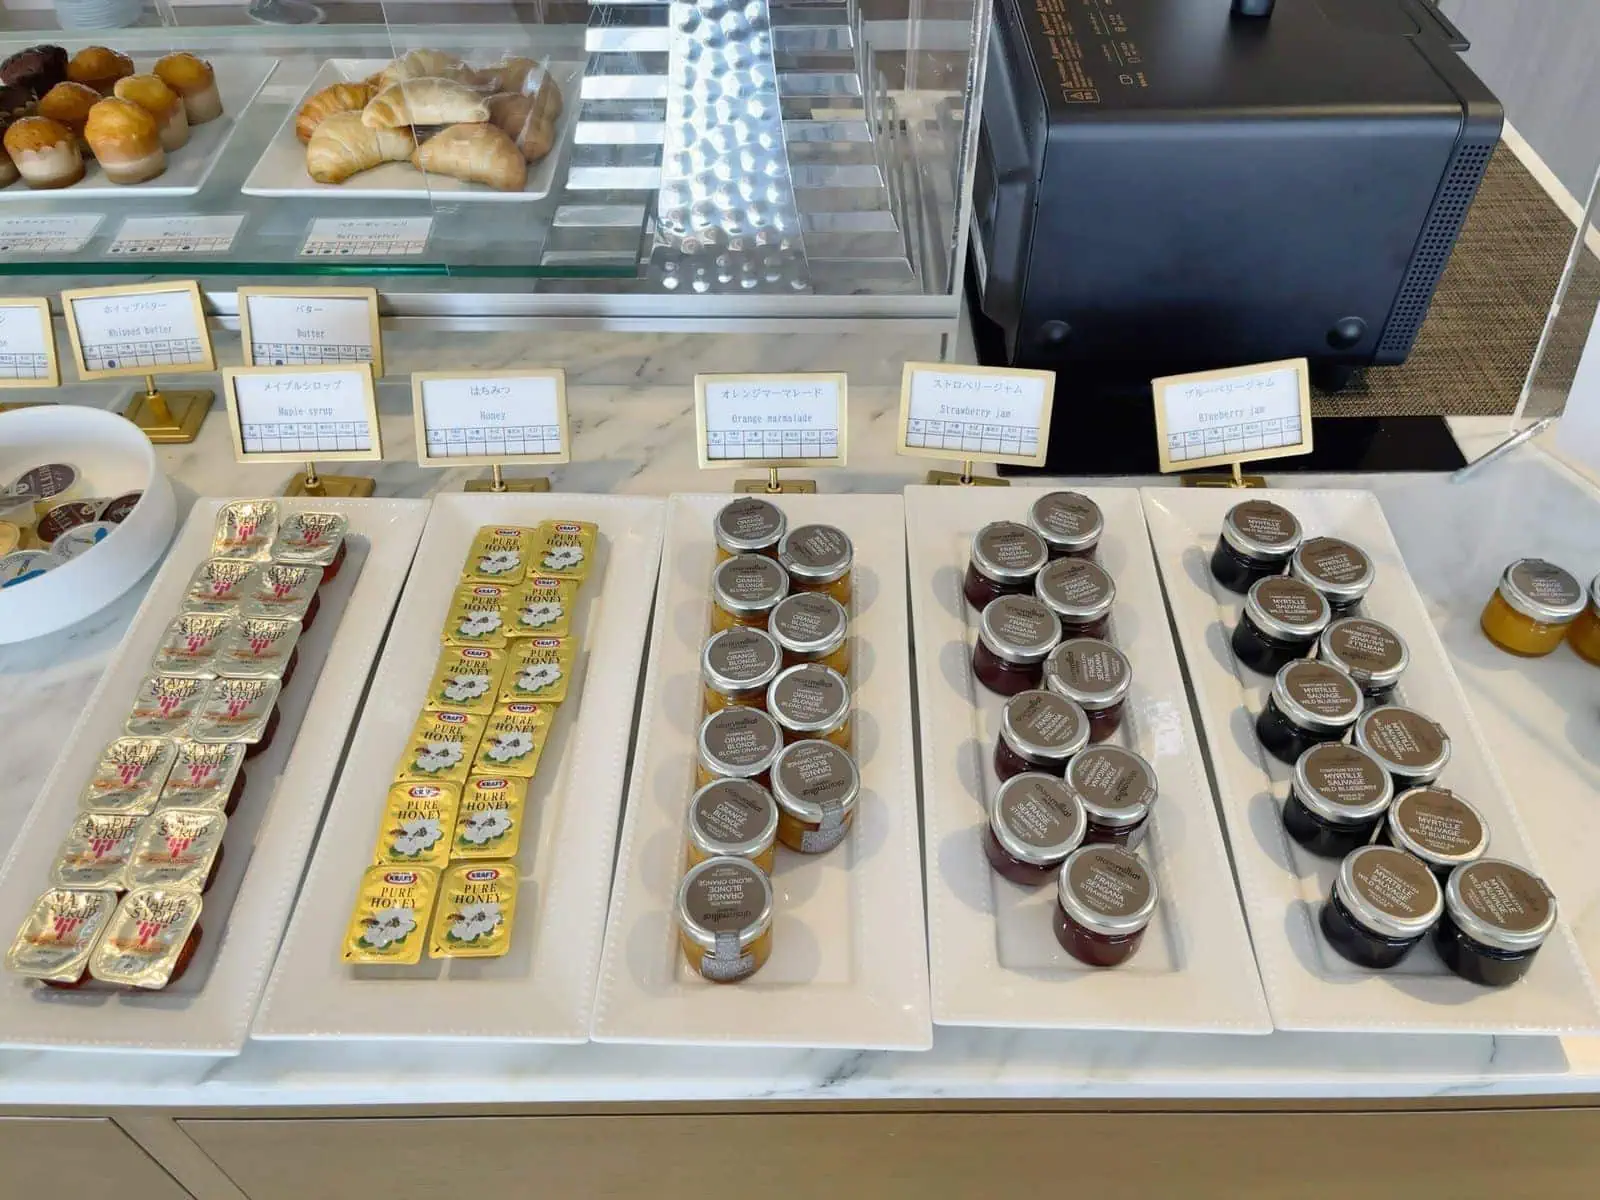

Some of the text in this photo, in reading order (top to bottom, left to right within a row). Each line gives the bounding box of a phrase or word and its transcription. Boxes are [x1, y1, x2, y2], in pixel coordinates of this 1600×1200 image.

[296, 303, 323, 313] バター
[143, 324, 172, 335] butter
[297, 328, 325, 338] Butter
[470, 385, 510, 396] はちみつ
[934, 379, 1023, 393] ストロベリージャム
[1185, 377, 1275, 400] ブルーベリージャム
[722, 388, 823, 399] オレンジマーマレード
[278, 407, 333, 417] Maple syrup
[480, 410, 506, 421] Honey
[940, 404, 1011, 418] Strawberry jam
[1198, 405, 1266, 422] Blueberry jam
[732, 414, 812, 424] Orange marmalade
[244, 631, 285, 640] SYRUP
[727, 652, 757, 661] ORANGE
[458, 659, 488, 667] PURE
[450, 666, 489, 675] HONEY
[218, 691, 264, 700] SYRUP
[505, 715, 532, 724] PURE
[434, 724, 463, 734] PURE
[495, 723, 536, 732] HONEY
[424, 732, 465, 742] HONEY
[724, 735, 756, 743] ORANGE
[1385, 722, 1406, 754] SAUVAGE
[1391, 719, 1414, 753] MYRTILLE
[727, 741, 756, 750] BLONDE
[183, 755, 229, 765] SYRUP
[800, 766, 831, 778] ORANGE
[1099, 767, 1117, 789] FRAISE
[475, 792, 506, 800] PURE
[407, 801, 439, 809] PURE
[466, 801, 511, 810] HONEY
[398, 810, 442, 820] HONEY
[717, 804, 747, 822] ORANGE
[1017, 802, 1048, 834] SENGANA
[1026, 802, 1050, 824] FRAISE
[713, 810, 741, 828] BLONDE
[1419, 816, 1461, 829] MYRTILLE
[83, 828, 135, 838] SYRUP
[1409, 827, 1430, 836] WILD
[1419, 823, 1460, 836] SAUVAGE
[389, 874, 413, 882] KRAFT
[1094, 874, 1122, 893] FRAISE
[1374, 868, 1415, 898] MYRTILLE
[381, 888, 414, 897] PURE
[464, 884, 497, 893] PURE
[1086, 879, 1124, 902] SENGANA
[1358, 872, 1415, 913] WILD BLUEBERRY
[1370, 874, 1409, 903] SAUVAGE
[454, 894, 501, 904] HONEY
[708, 893, 745, 901] ORANGE
[1080, 883, 1124, 908] STRAWBERRY
[1468, 872, 1506, 925] WILD BLUEBERRY
[1482, 880, 1508, 914] SAUVAGE
[1490, 878, 1518, 913] MYRTILLE
[130, 907, 180, 924] SYRUP
